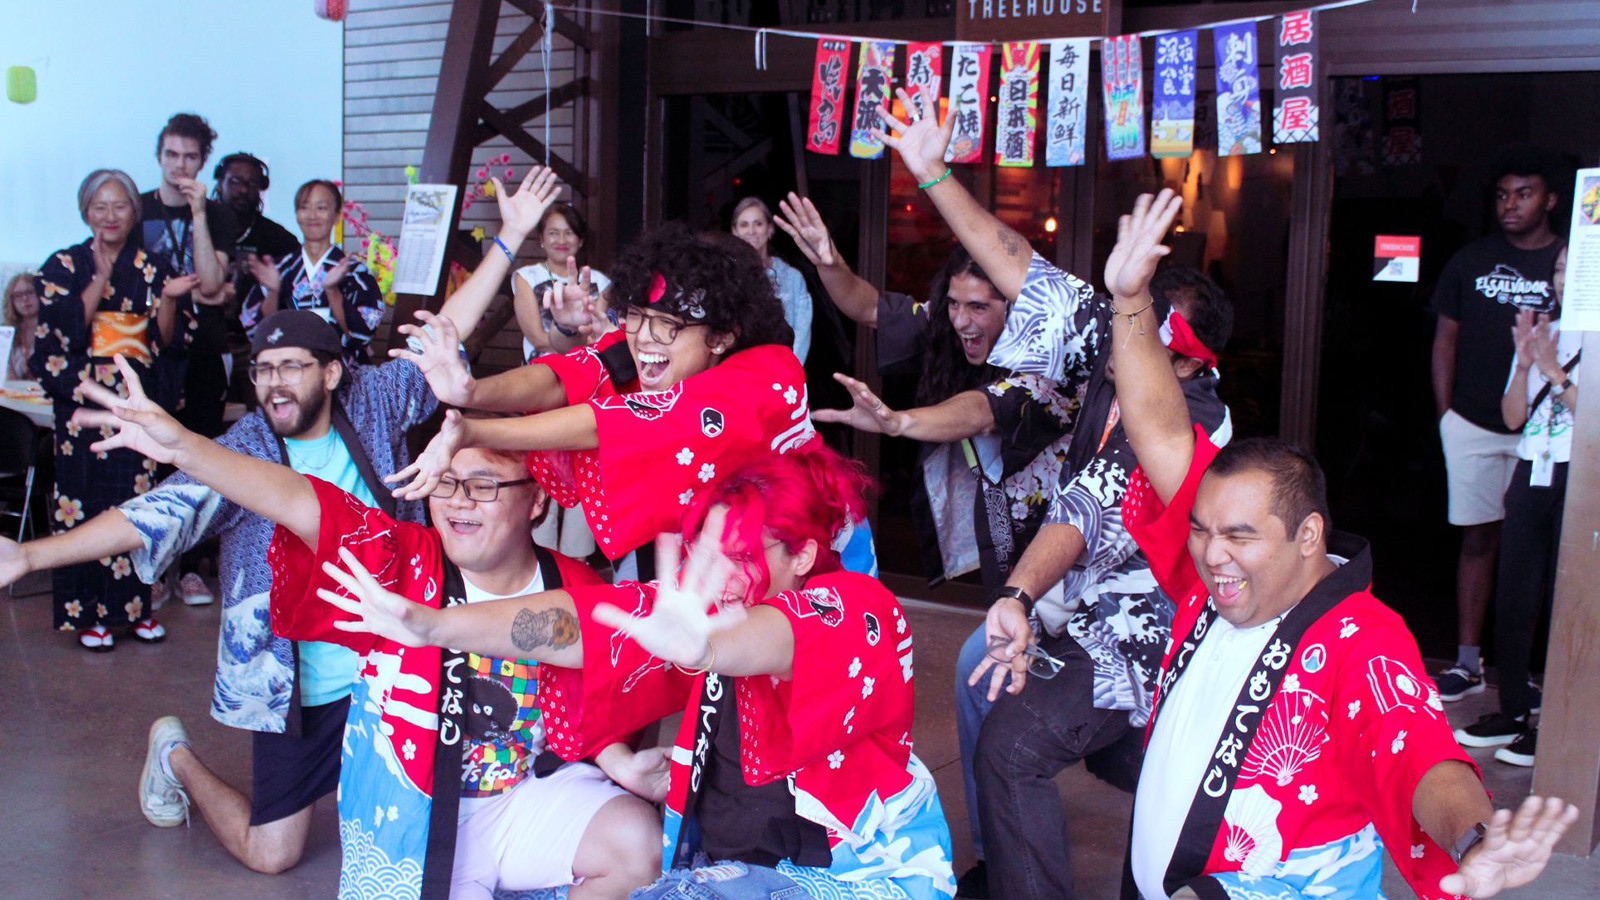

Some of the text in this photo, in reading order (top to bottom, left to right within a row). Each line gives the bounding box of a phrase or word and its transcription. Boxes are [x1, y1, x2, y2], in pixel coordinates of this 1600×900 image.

[969, 0, 1102, 19] TREEHOUSE
[957, 54, 979, 134] たこ焼
[1053, 44, 1081, 148] 毎日新鮮
[1281, 10, 1312, 130] 居酒屋
[1006, 80, 1027, 159] 日本酒
[1203, 638, 1291, 798] おもてなし
